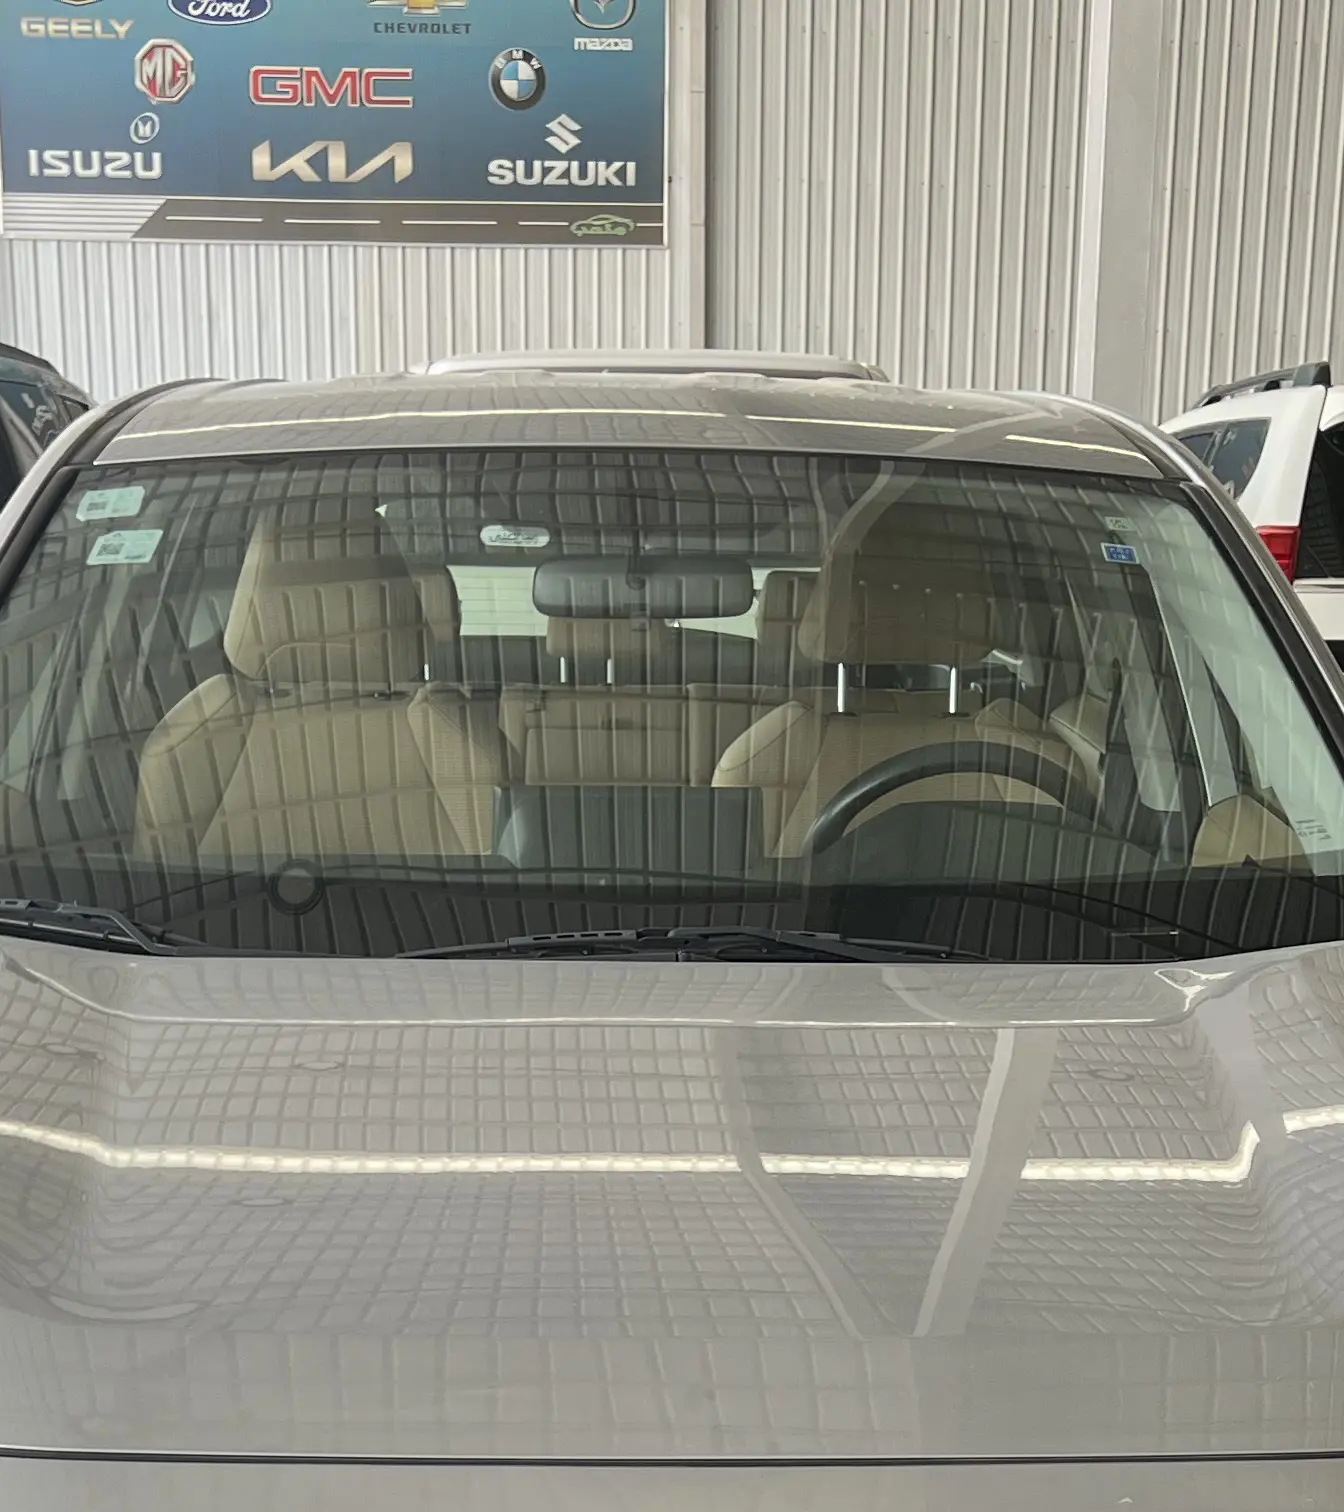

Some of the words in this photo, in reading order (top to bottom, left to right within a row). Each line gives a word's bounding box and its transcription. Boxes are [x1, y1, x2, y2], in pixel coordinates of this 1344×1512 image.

[20, 17, 134, 39] GEELY
[373, 22, 472, 34] CHEVROLET
[142, 47, 188, 98] MG
[250, 66, 414, 108] GMC
[28, 149, 163, 180] ISUZU
[487, 160, 637, 187] SUZUKI
